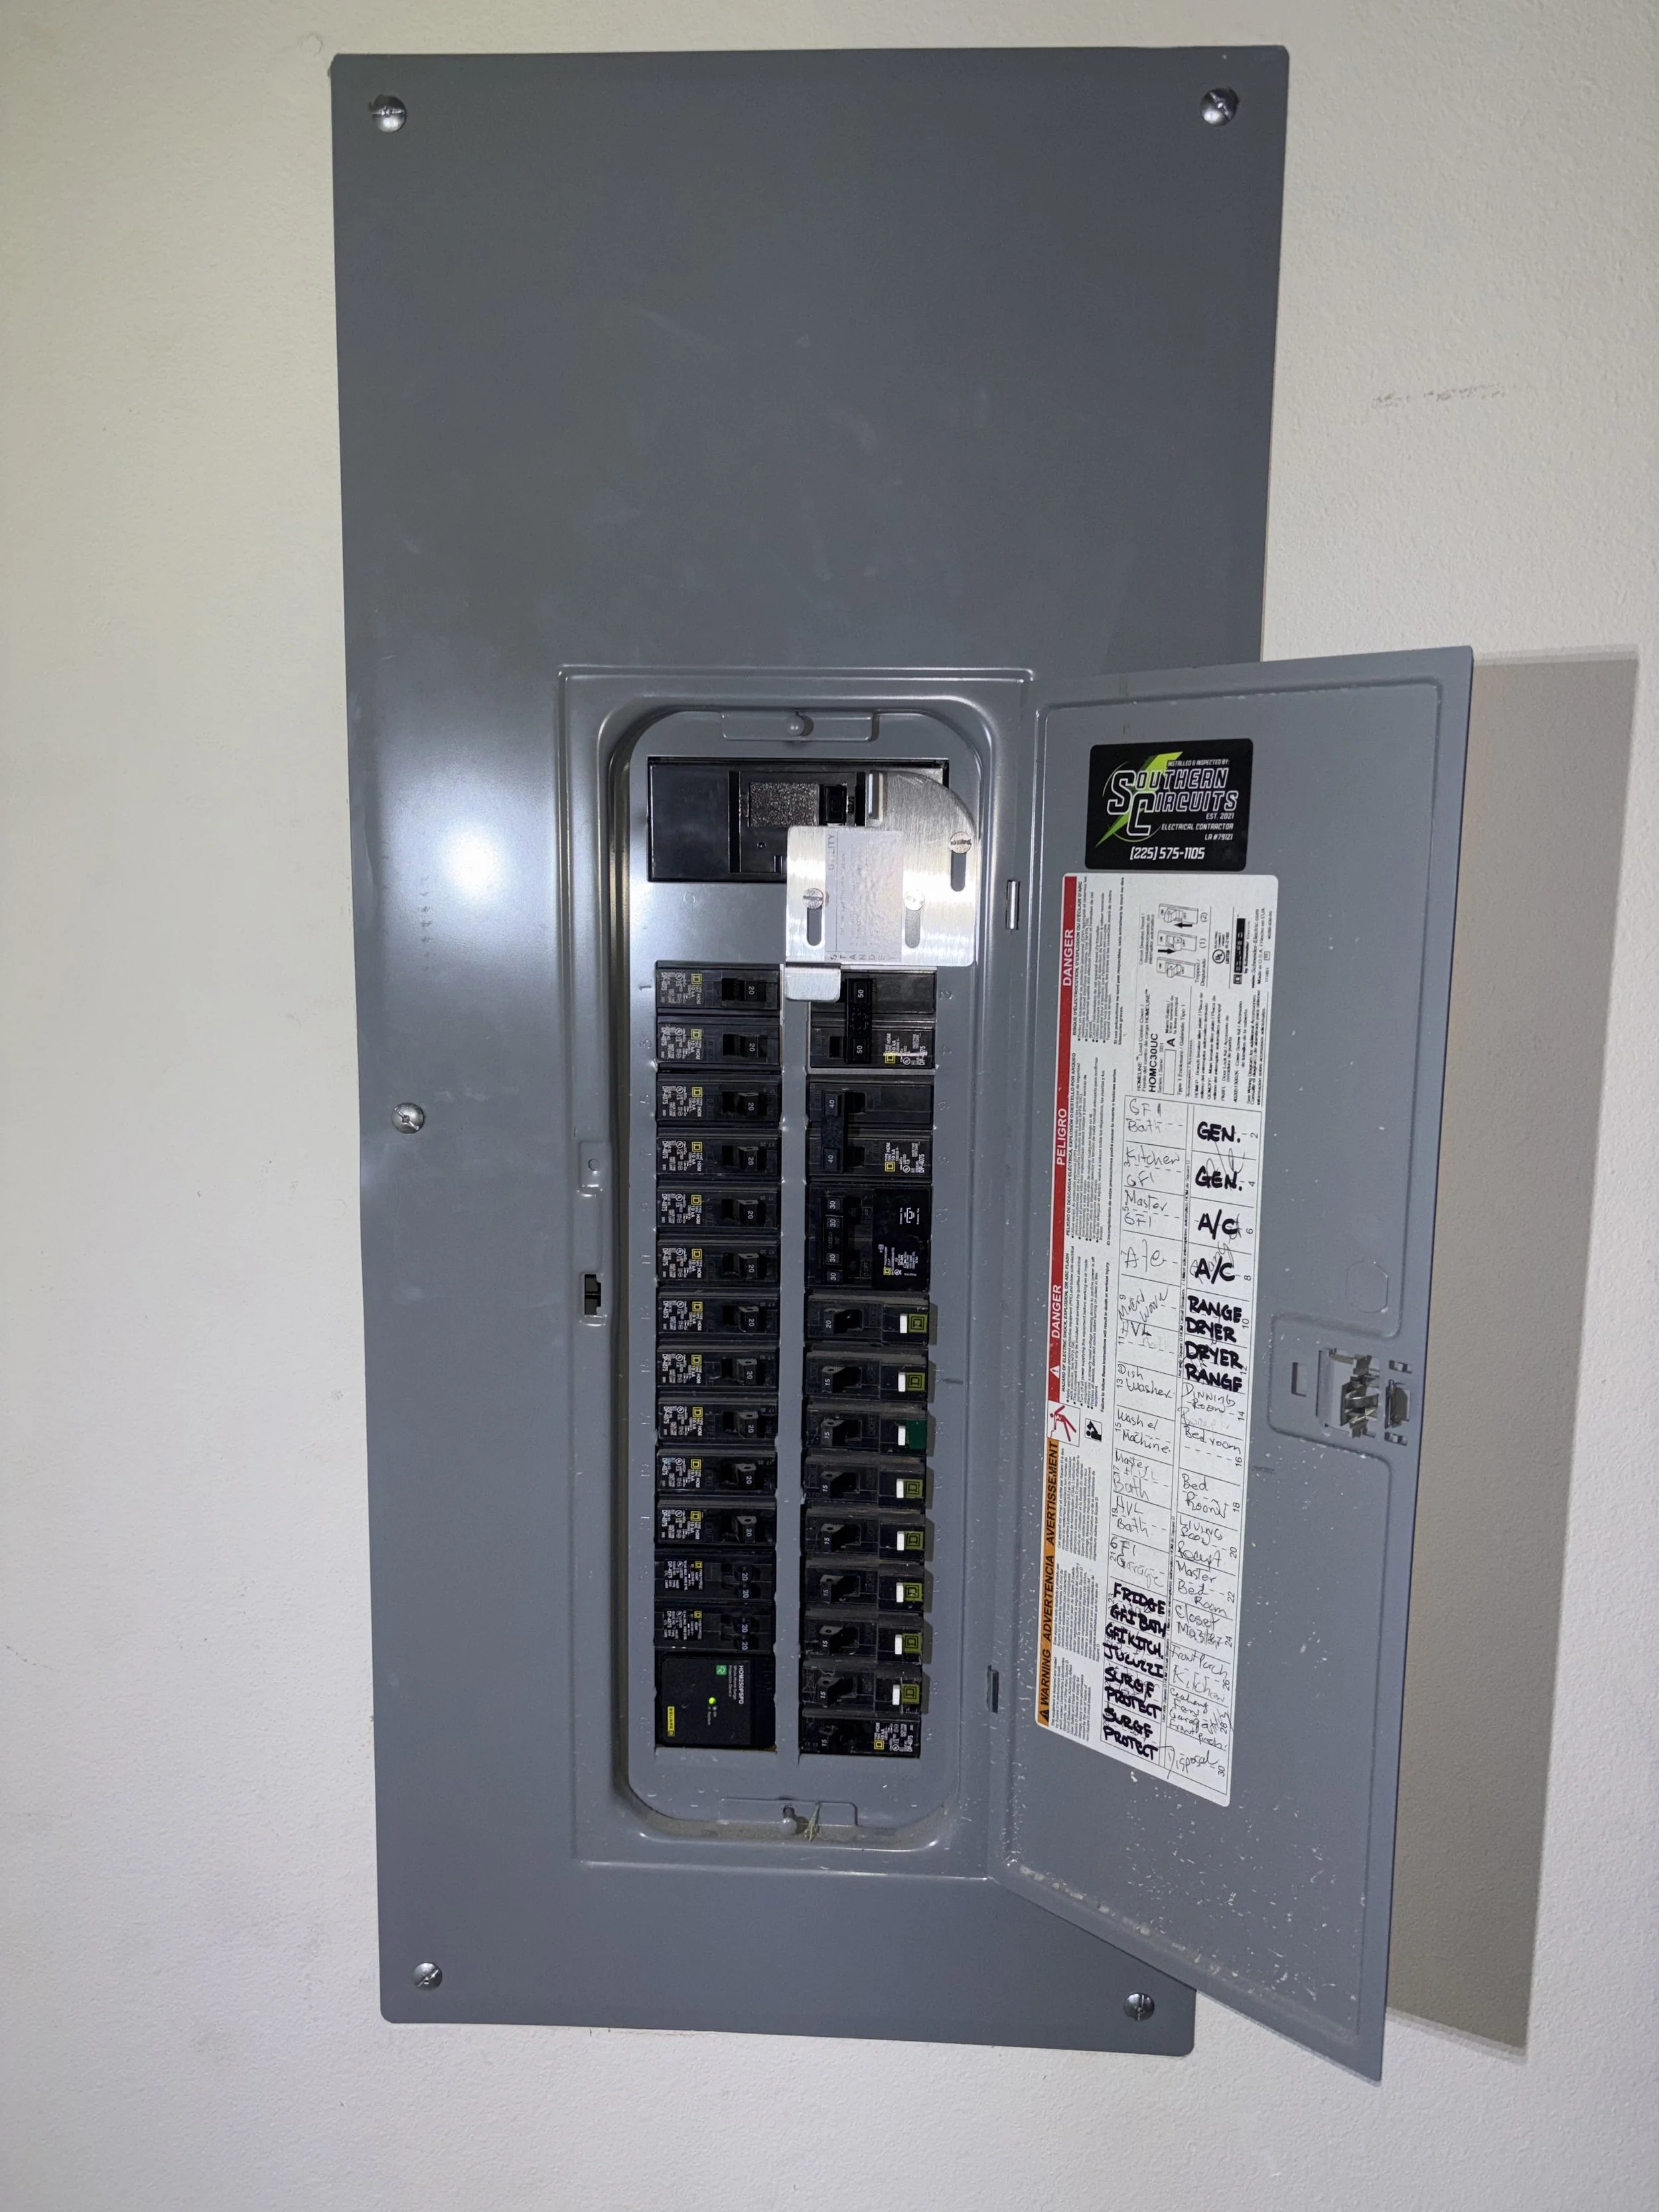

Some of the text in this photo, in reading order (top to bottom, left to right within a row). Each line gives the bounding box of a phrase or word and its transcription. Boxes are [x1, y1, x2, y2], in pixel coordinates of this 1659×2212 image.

[1107, 768, 1228, 815] SOUTHERN
[1127, 790, 1238, 836] CIRCUITS
[1130, 847, 1205, 860] (225) 575-1105
[1062, 929, 1074, 986] DANGER
[749, 986, 755, 995] 20
[749, 1043, 755, 1052] 20
[1167, 1038, 1175, 1047] A
[1149, 1033, 1158, 1092] HOMC30UC
[748, 1102, 754, 1111] 20
[830, 1100, 835, 1108] 40
[1056, 1108, 1066, 1165] PELIGRO
[1197, 1121, 1240, 1143] GEN.
[748, 1157, 754, 1165] 20
[828, 1155, 833, 1163] 40
[1195, 1165, 1242, 1191] GEN.
[830, 1201, 835, 1209] 30
[747, 1211, 753, 1219] 20
[830, 1219, 836, 1228] 30
[1198, 1209, 1239, 1240] A/C
[748, 1264, 755, 1273] 20
[1194, 1256, 1235, 1284] A/C
[830, 1272, 837, 1281] 30
[1051, 1284, 1061, 1339] DANGER
[1188, 1295, 1242, 1323] RANGE
[749, 1318, 755, 1327] 20
[826, 1320, 831, 1329] 20
[1242, 1319, 1250, 1329] 10
[1185, 1317, 1237, 1343] DRYER
[1185, 1341, 1243, 1370] DRYER
[747, 1370, 753, 1380] 20
[1185, 1363, 1242, 1392] RANGE
[1116, 1378, 1123, 1388] 13
[1238, 1411, 1245, 1421] 14
[748, 1424, 754, 1434] 20
[1115, 1423, 1121, 1432] 15
[1236, 1457, 1242, 1467] 16
[746, 1475, 752, 1485] 20
[1046, 1441, 1058, 1545] AVERTISSEMENT
[1233, 1503, 1240, 1512] 18
[746, 1528, 752, 1537] 20
[1230, 1547, 1237, 1558] 20
[742, 1572, 749, 1581] 20
[743, 1589, 749, 1598] 20
[1043, 1555, 1054, 1642] ADVERTENCIA
[1114, 1582, 1166, 1615] FRIDGE
[1228, 1591, 1235, 1603] 22
[742, 1624, 748, 1633] 20
[1138, 1613, 1166, 1637] BATH
[742, 1642, 748, 1651] 20
[1225, 1636, 1232, 1647] 24
[1041, 1649, 1050, 1706] WARNING
[1105, 1666, 1155, 1698] SURGE
[1222, 1680, 1230, 1691] 26
[1105, 1686, 1161, 1718] PROTECT
[1103, 1707, 1153, 1737] SURGE
[1220, 1723, 1228, 1734] 28
[1103, 1726, 1159, 1760] PROTECT
[1218, 1766, 1225, 1777] 30
